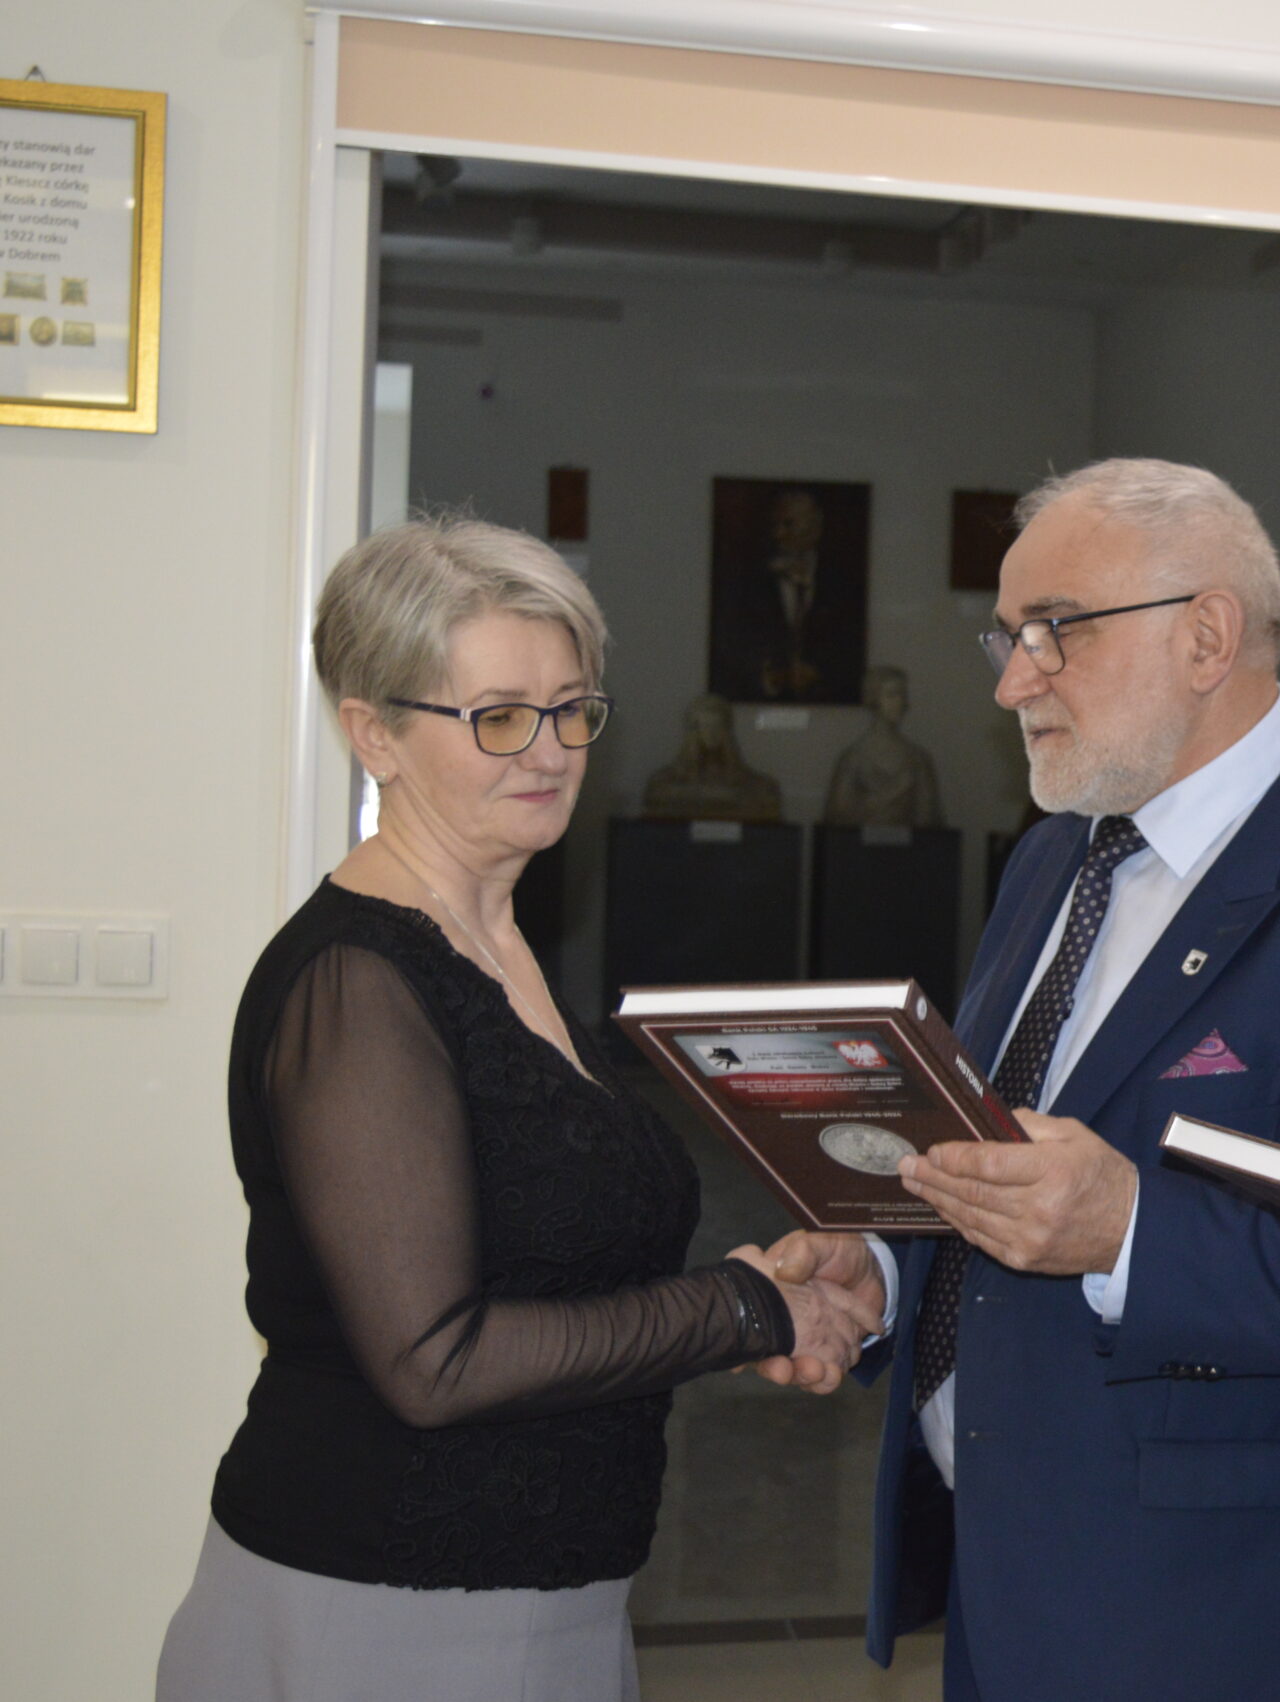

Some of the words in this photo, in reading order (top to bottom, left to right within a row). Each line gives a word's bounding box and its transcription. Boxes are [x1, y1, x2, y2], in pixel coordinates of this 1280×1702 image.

[13, 141, 71, 156] stanowią
[74, 144, 96, 156] dar
[50, 161, 85, 174] przez
[50, 196, 88, 211] domu
[18, 213, 79, 230] urodzoną
[4, 228, 35, 243] 1922
[38, 232, 68, 245] roku
[8, 247, 62, 262] Dobrem
[955, 1053, 984, 1099] HISTORIA
